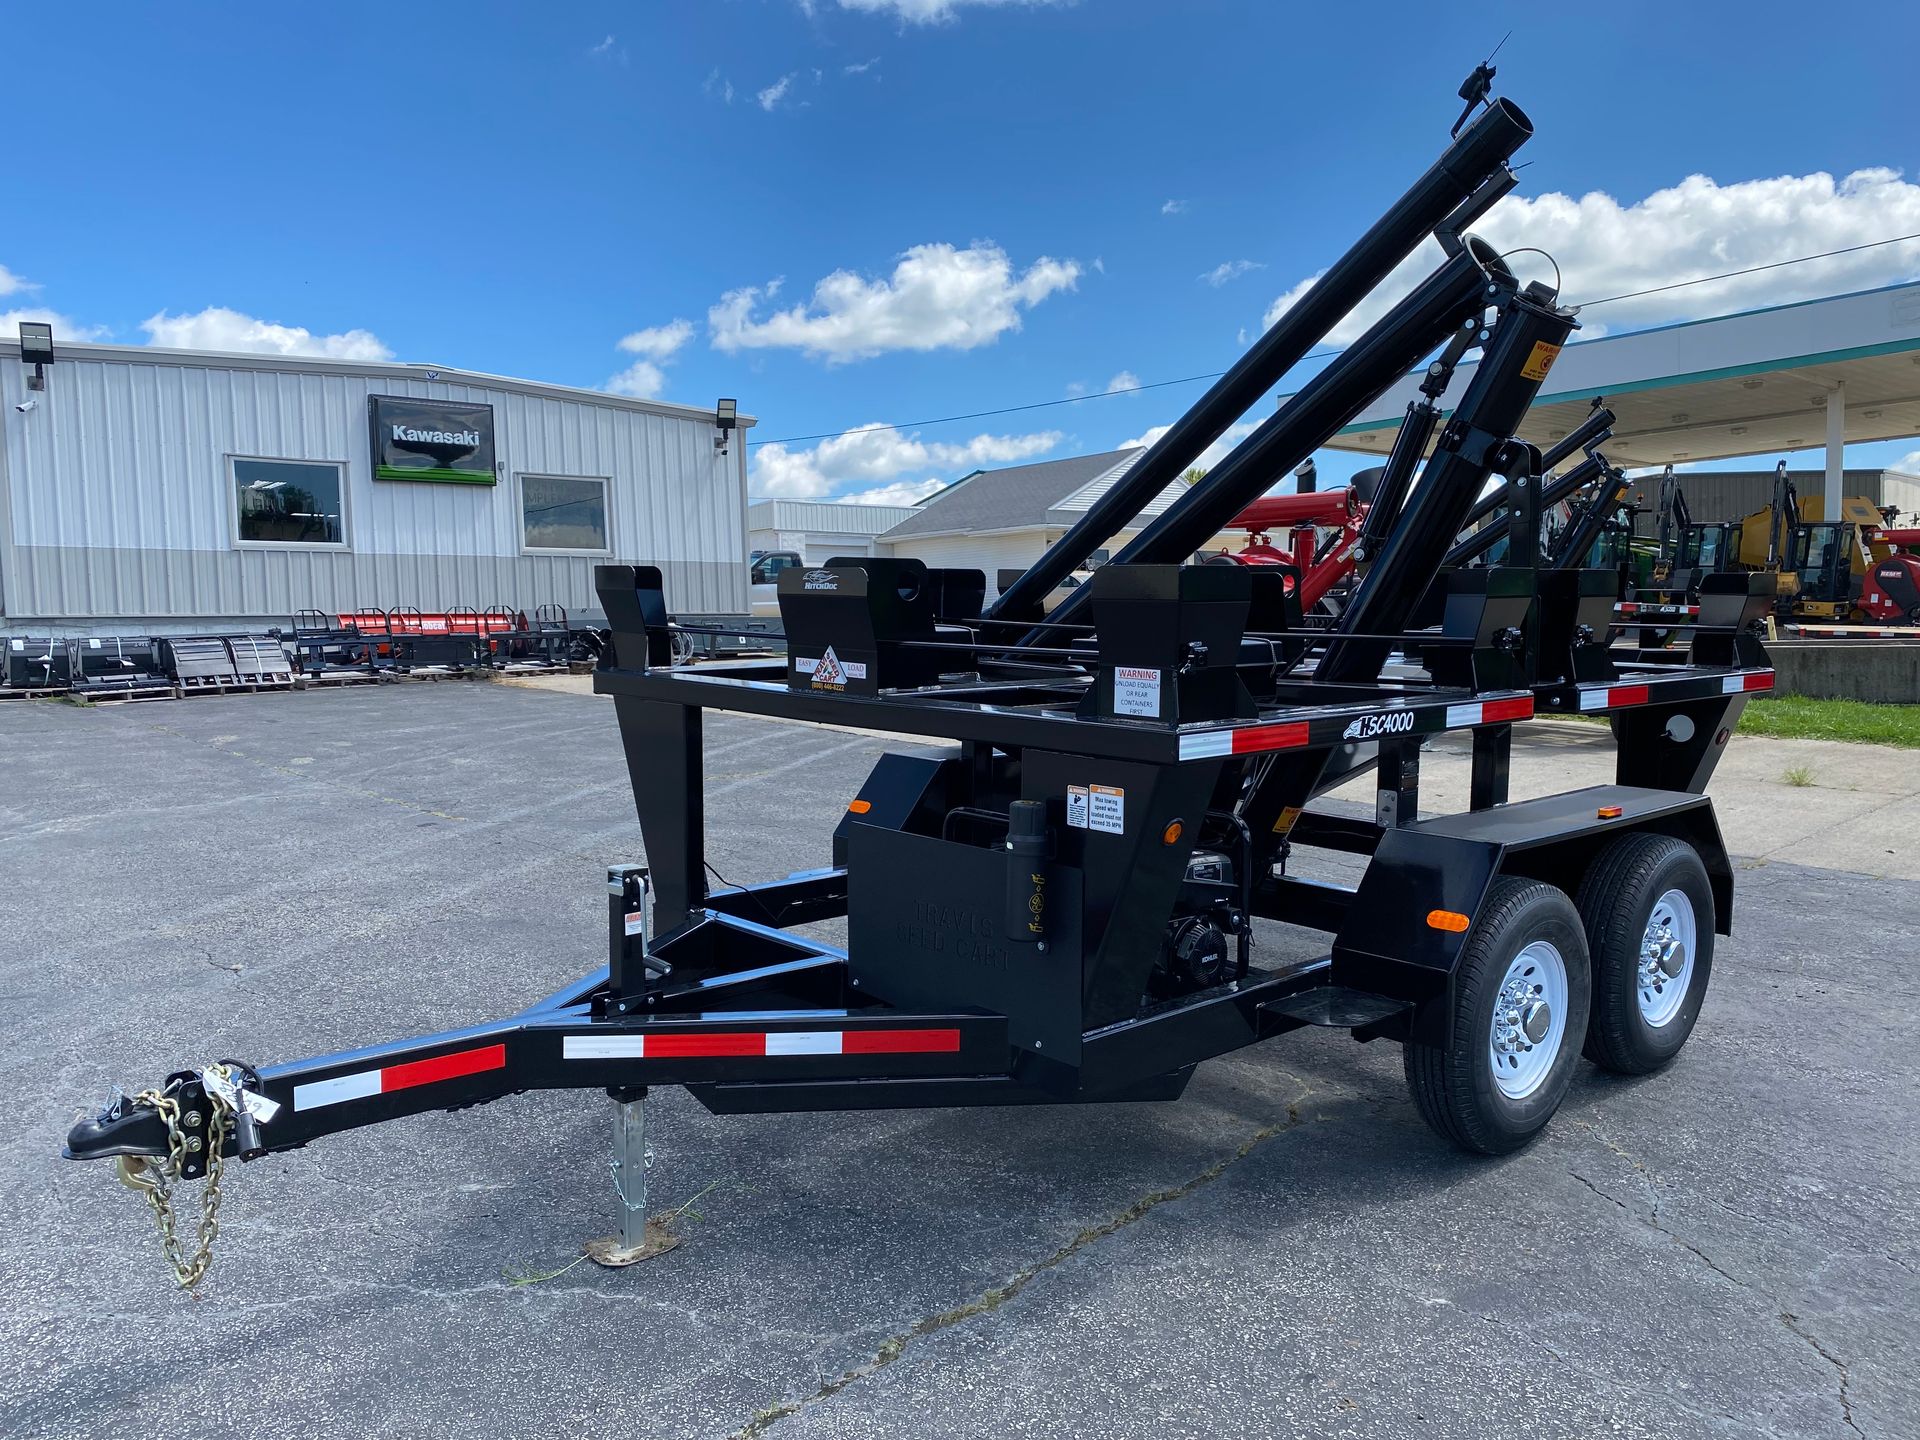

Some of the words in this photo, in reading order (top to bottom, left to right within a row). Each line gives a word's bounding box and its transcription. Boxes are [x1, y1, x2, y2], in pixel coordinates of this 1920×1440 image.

[1536, 343, 1560, 353] WARN
[392, 424, 480, 445] Kawasaki
[798, 659, 811, 667] EASY
[847, 664, 865, 672] LOAD
[819, 674, 837, 682] CART
[1119, 669, 1157, 680] WARNING
[1121, 699, 1153, 708] CONTAINERS
[912, 896, 993, 938] TRAVIS
